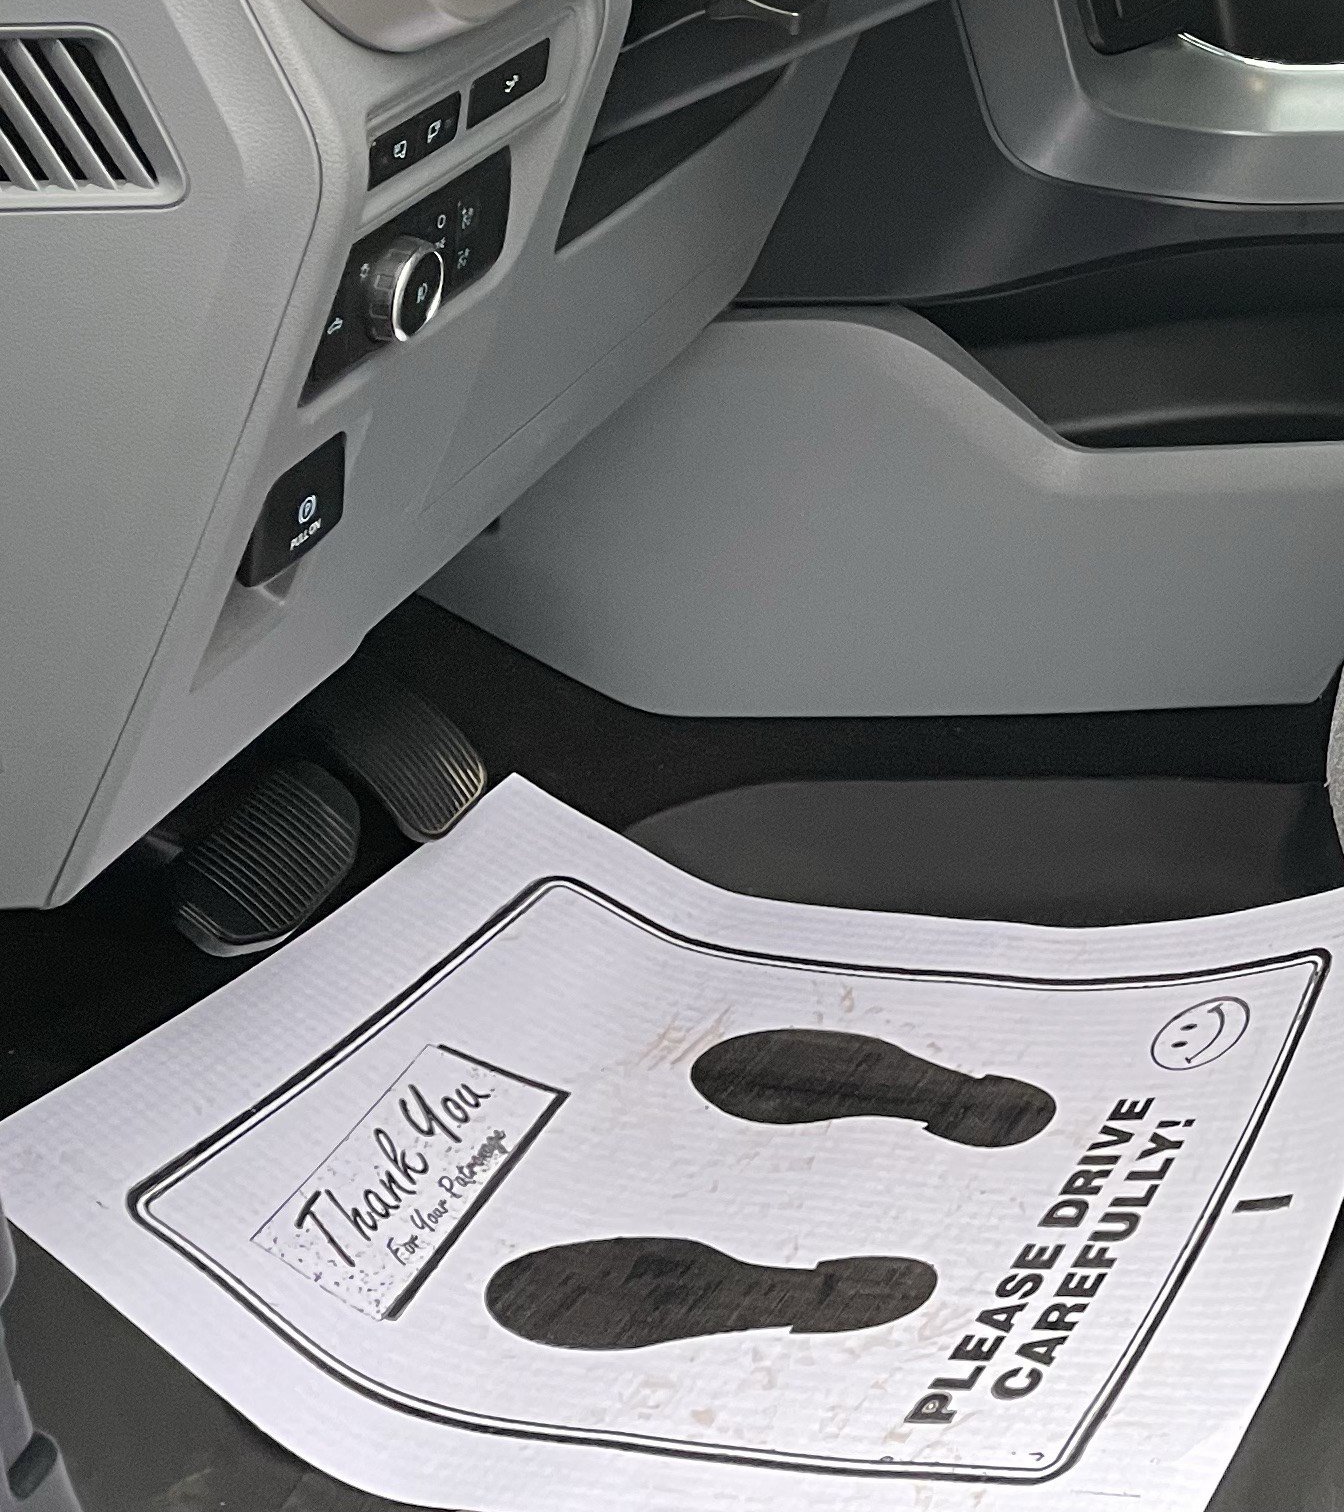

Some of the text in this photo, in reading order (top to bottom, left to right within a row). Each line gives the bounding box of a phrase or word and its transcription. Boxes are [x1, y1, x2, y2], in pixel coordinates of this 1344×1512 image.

[294, 1082, 493, 1268] Thank You
[903, 1096, 1156, 1425] PLEASE DRIVE
[990, 1118, 1196, 1401] CAREFULLY!
